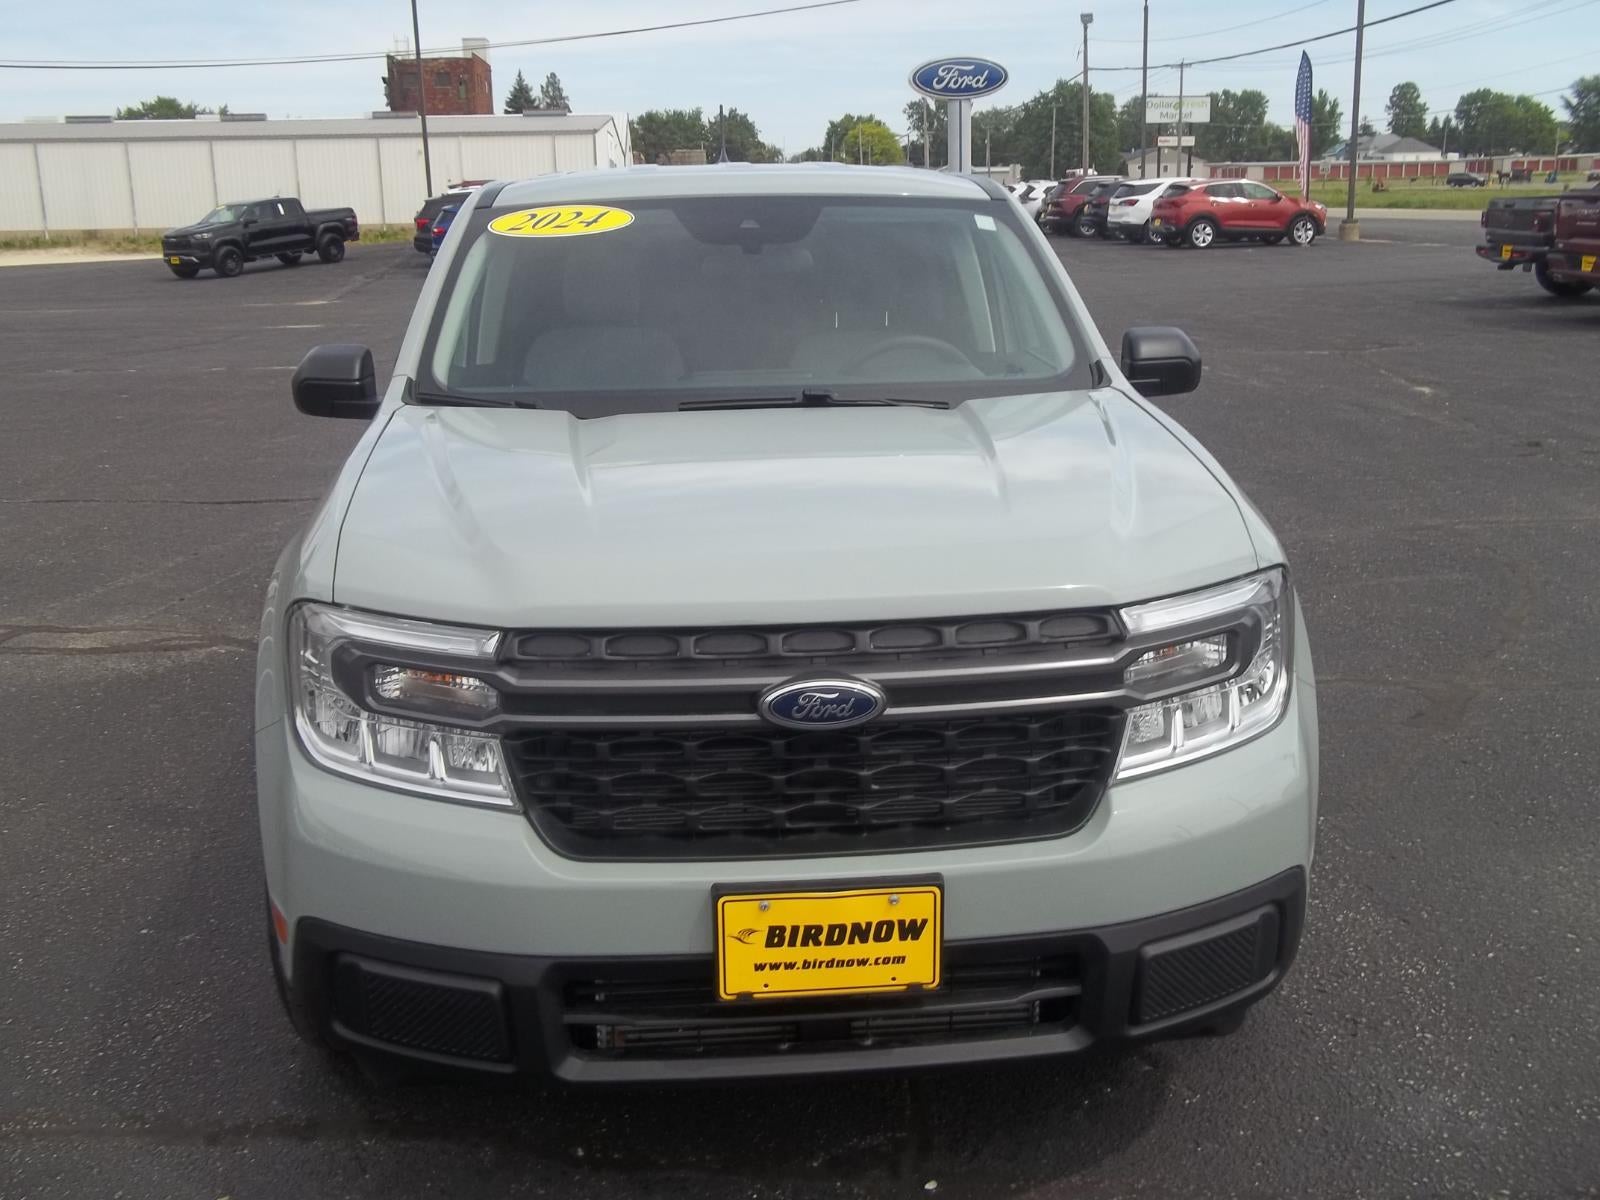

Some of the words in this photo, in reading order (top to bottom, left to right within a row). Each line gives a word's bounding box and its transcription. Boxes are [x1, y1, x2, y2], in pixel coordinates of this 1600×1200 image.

[933, 64, 989, 90] Ford
[1146, 100, 1173, 110] Dollar
[1160, 111, 1193, 120] Maret
[506, 211, 610, 231] 2024
[792, 692, 855, 719] Ford
[764, 918, 929, 948] BIRDNOW
[754, 955, 907, 972] www.birdnow.com
